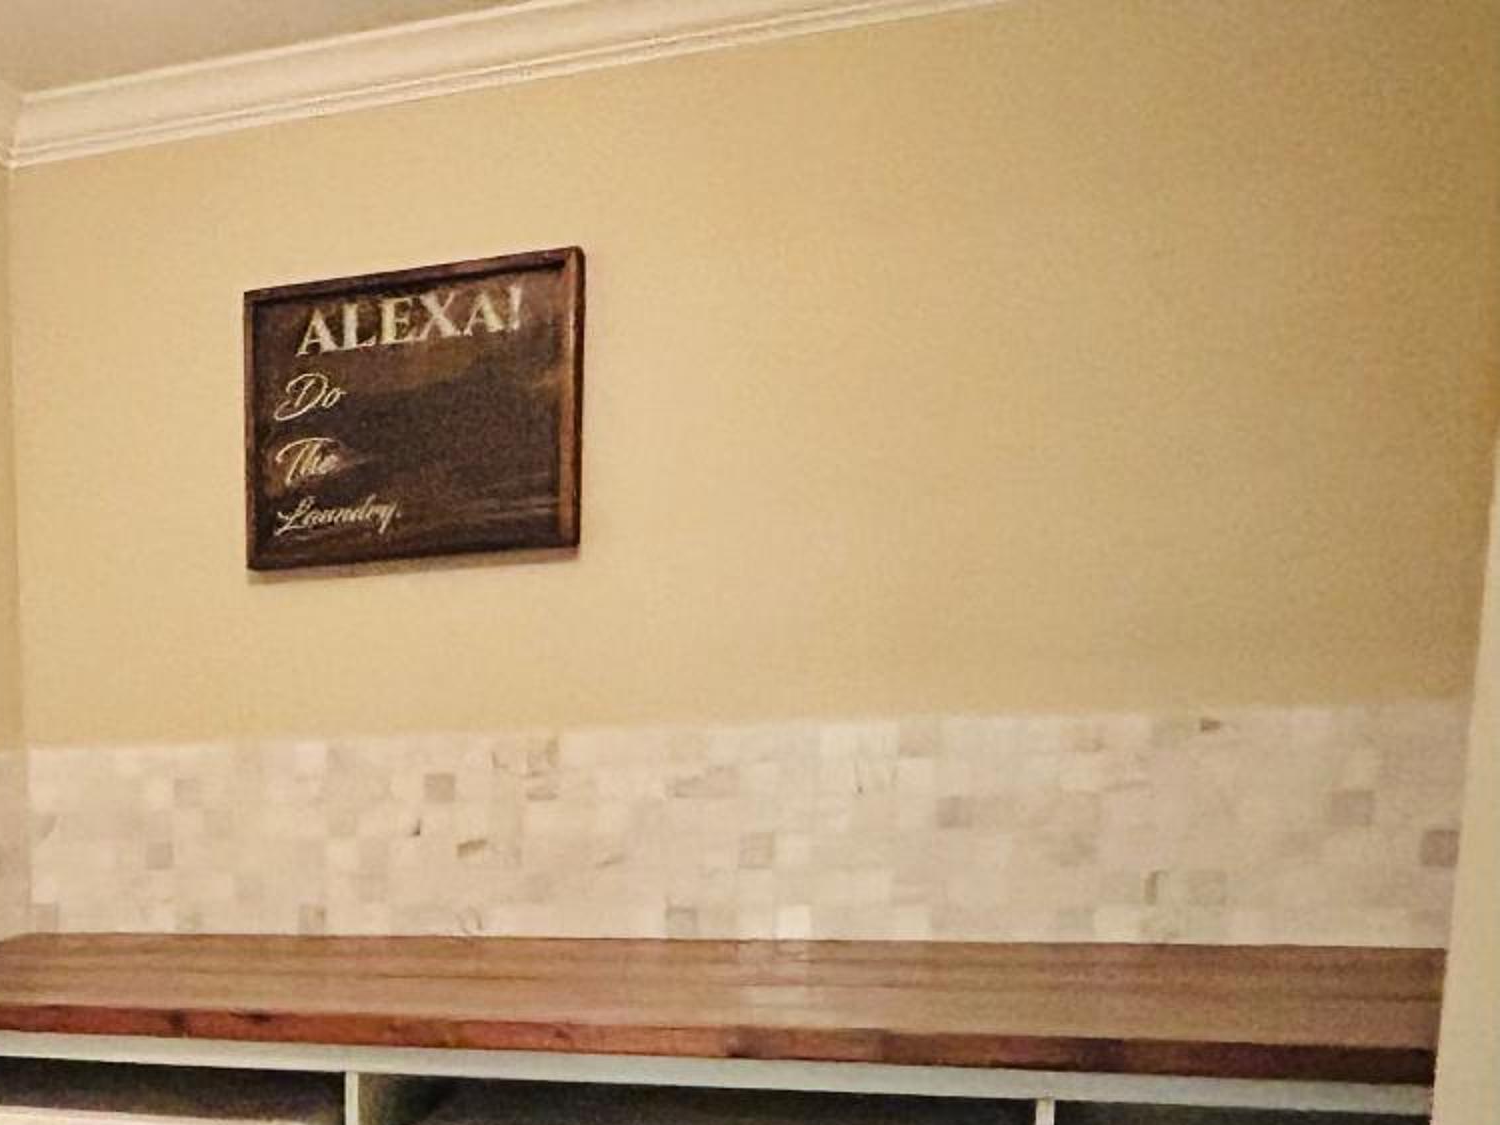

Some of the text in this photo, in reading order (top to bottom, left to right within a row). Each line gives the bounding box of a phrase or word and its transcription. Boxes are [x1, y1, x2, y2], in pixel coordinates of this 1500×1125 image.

[295, 286, 522, 355] ALEXA!
[274, 372, 346, 421] Do
[275, 436, 342, 487] The
